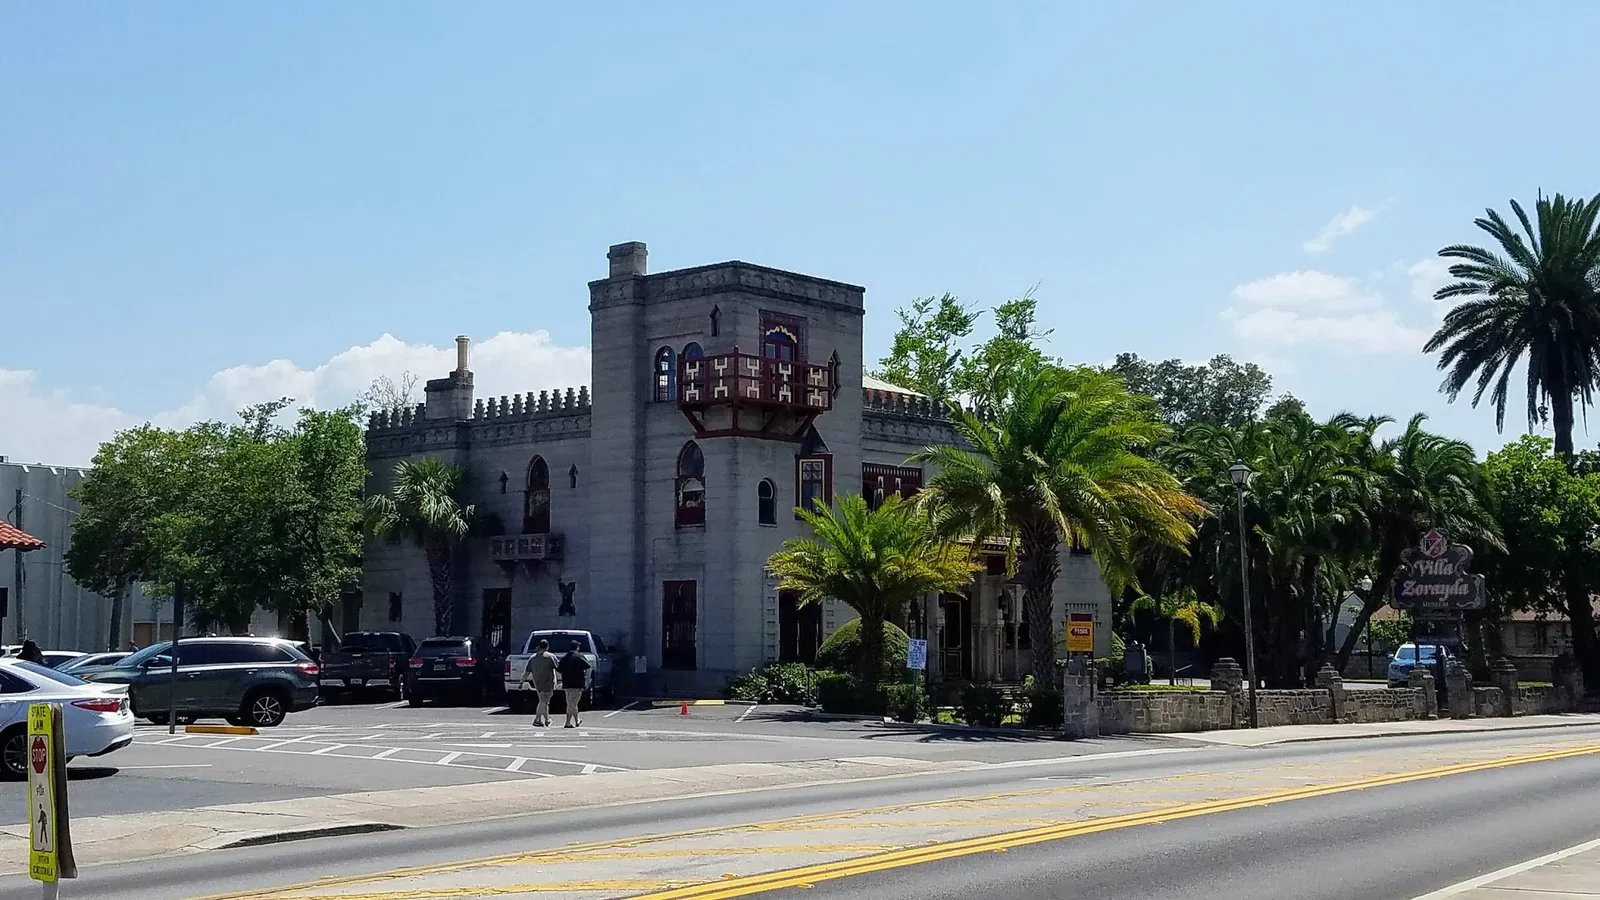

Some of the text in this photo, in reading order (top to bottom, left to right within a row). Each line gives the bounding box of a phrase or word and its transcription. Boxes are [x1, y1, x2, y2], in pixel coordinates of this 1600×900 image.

[1413, 558, 1454, 577] Villa
[1401, 578, 1469, 601] Zorayda
[31, 706, 46, 718] STATE
[33, 720, 44, 731] LAW
[32, 748, 46, 762] STOP
